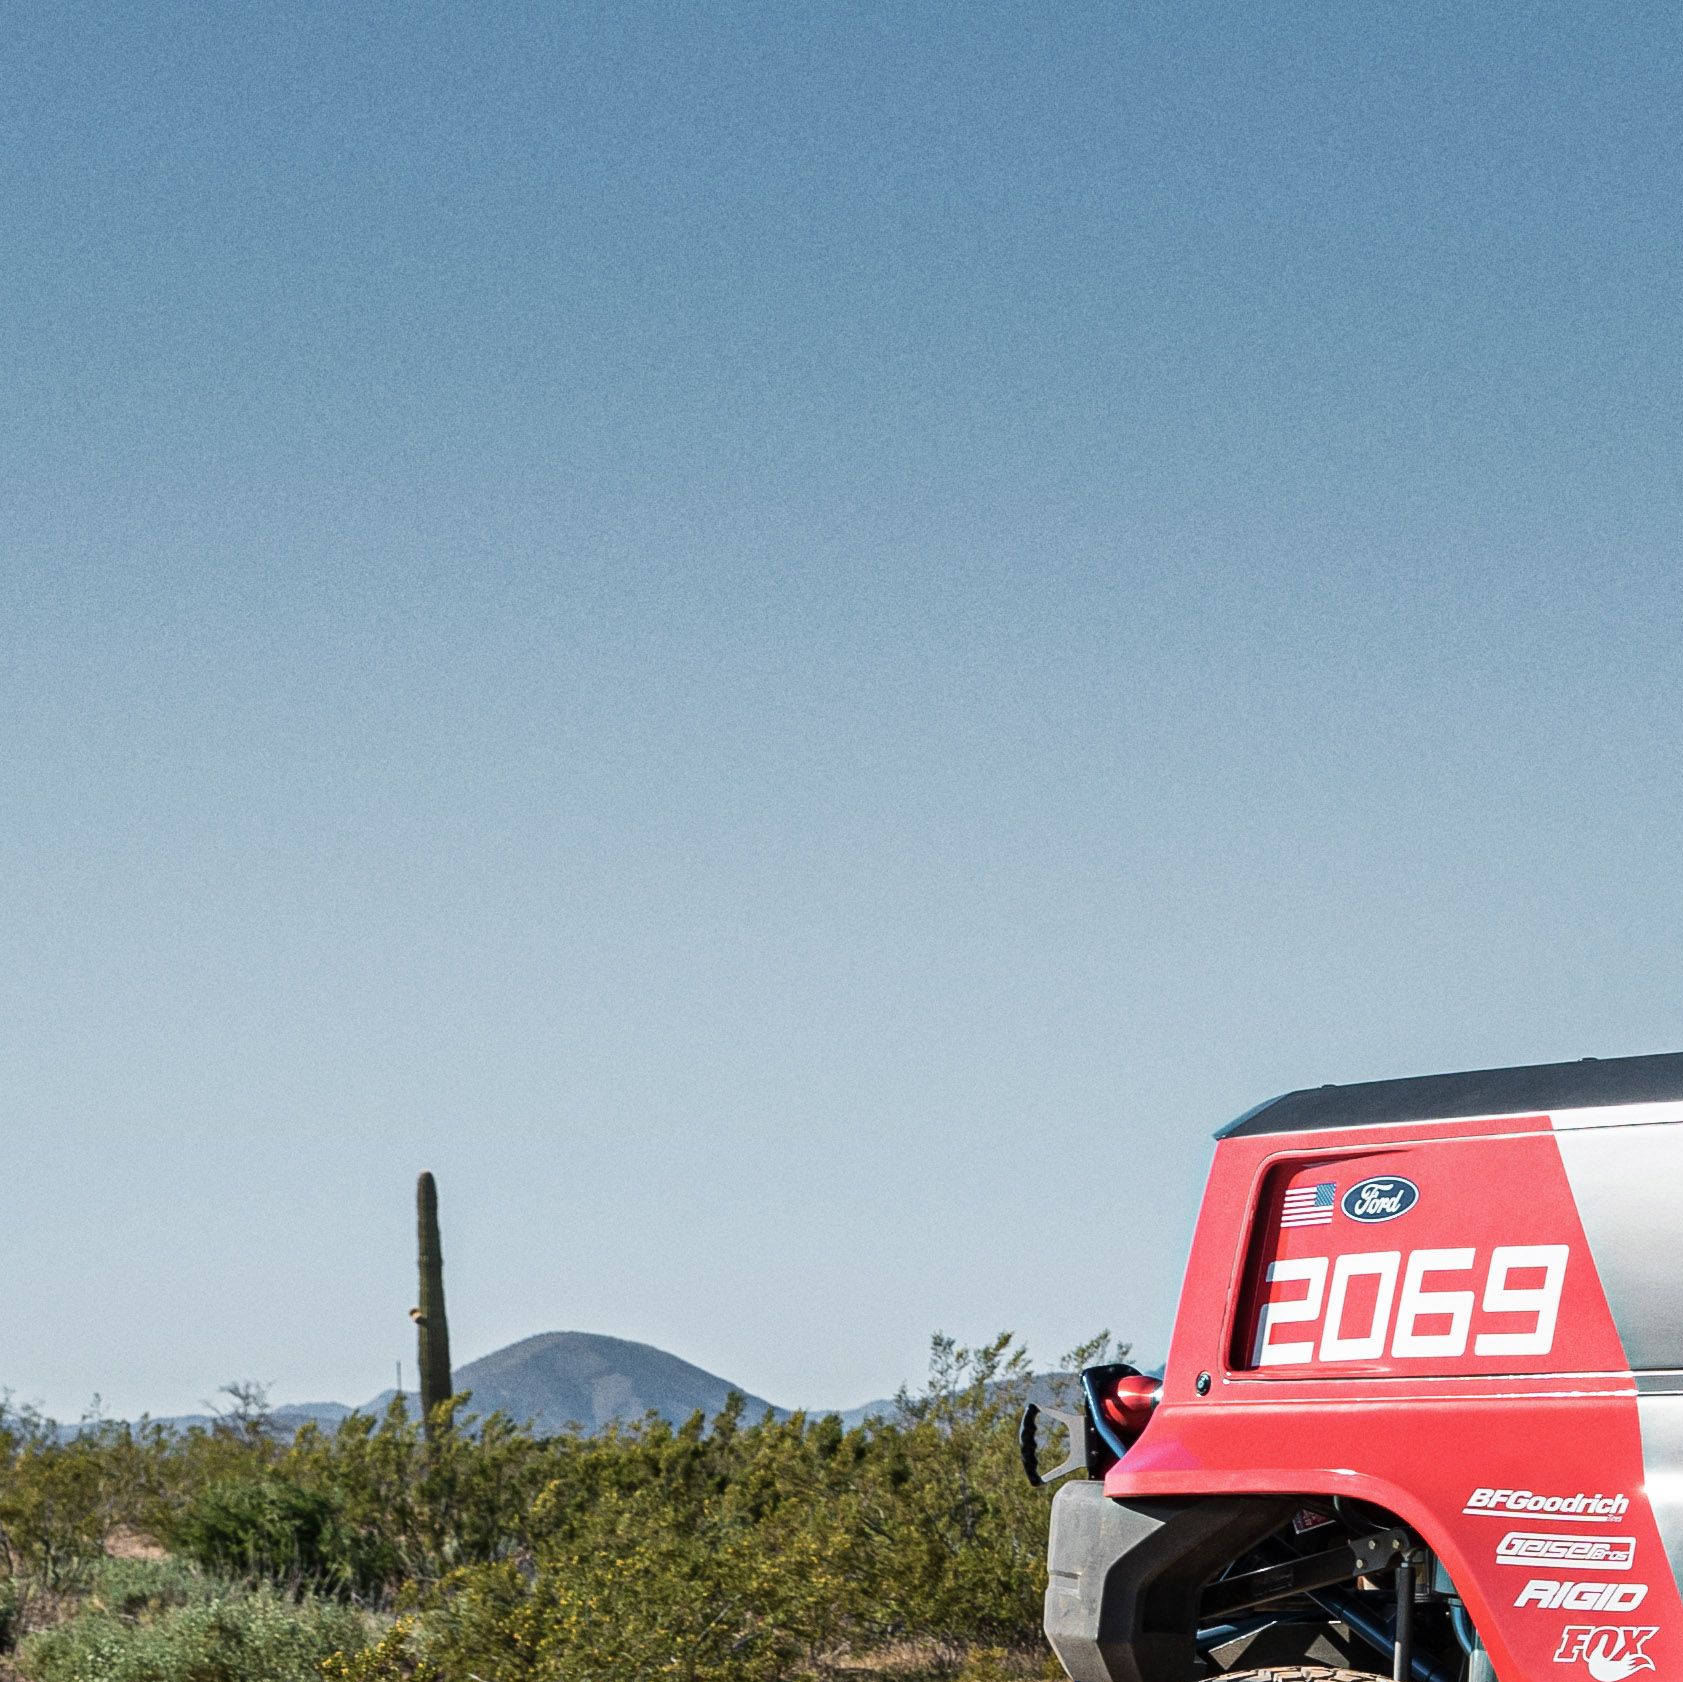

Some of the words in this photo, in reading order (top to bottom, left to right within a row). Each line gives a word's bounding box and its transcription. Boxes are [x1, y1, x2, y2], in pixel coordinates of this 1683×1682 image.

[1354, 1182, 1405, 1216] Ford
[1251, 1244, 1570, 1367] 2069
[1467, 1487, 1630, 1515] BFGoodrich
[1513, 1579, 1648, 1612] RIGID
[1553, 1625, 1660, 1672] FOX
